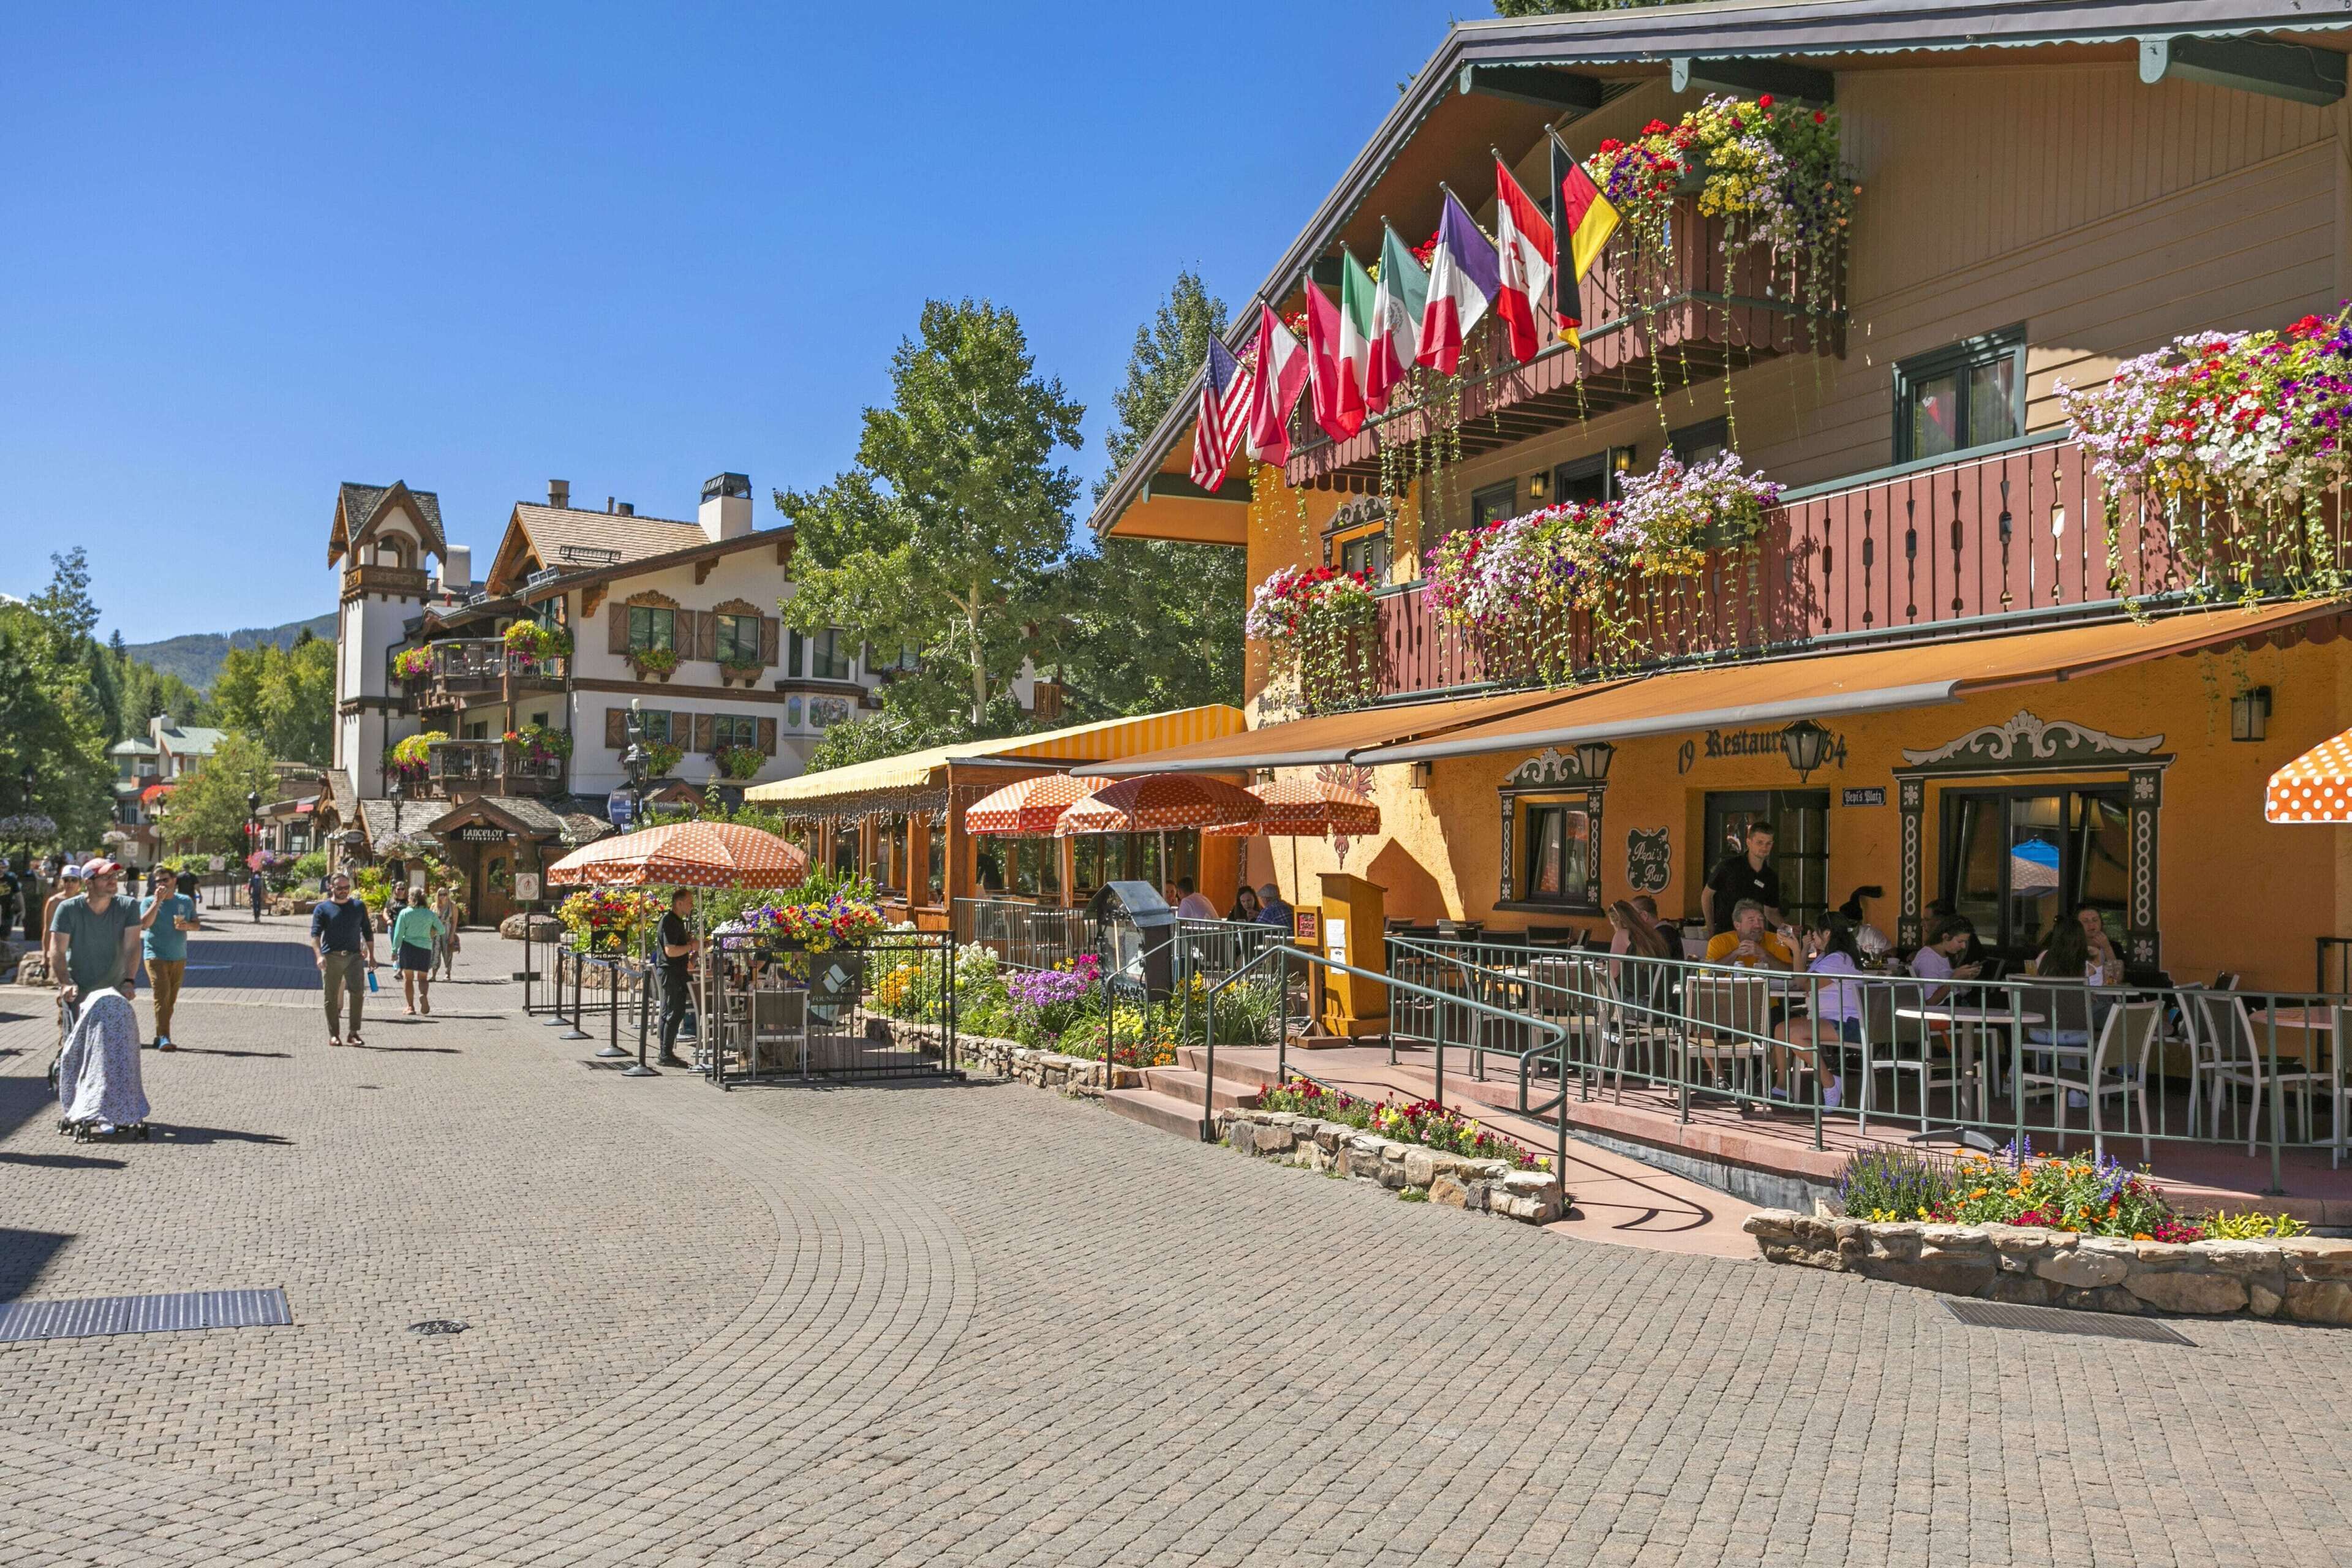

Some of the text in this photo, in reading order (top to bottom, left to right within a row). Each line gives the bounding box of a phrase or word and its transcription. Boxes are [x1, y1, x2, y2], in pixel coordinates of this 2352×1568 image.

[1705, 729, 1789, 758] Restaura
[1678, 739, 1695, 775] 19
[462, 829, 504, 837] LANCELOT
[1632, 841, 1662, 864] Pepi's
[1644, 864, 1664, 882] Bar
